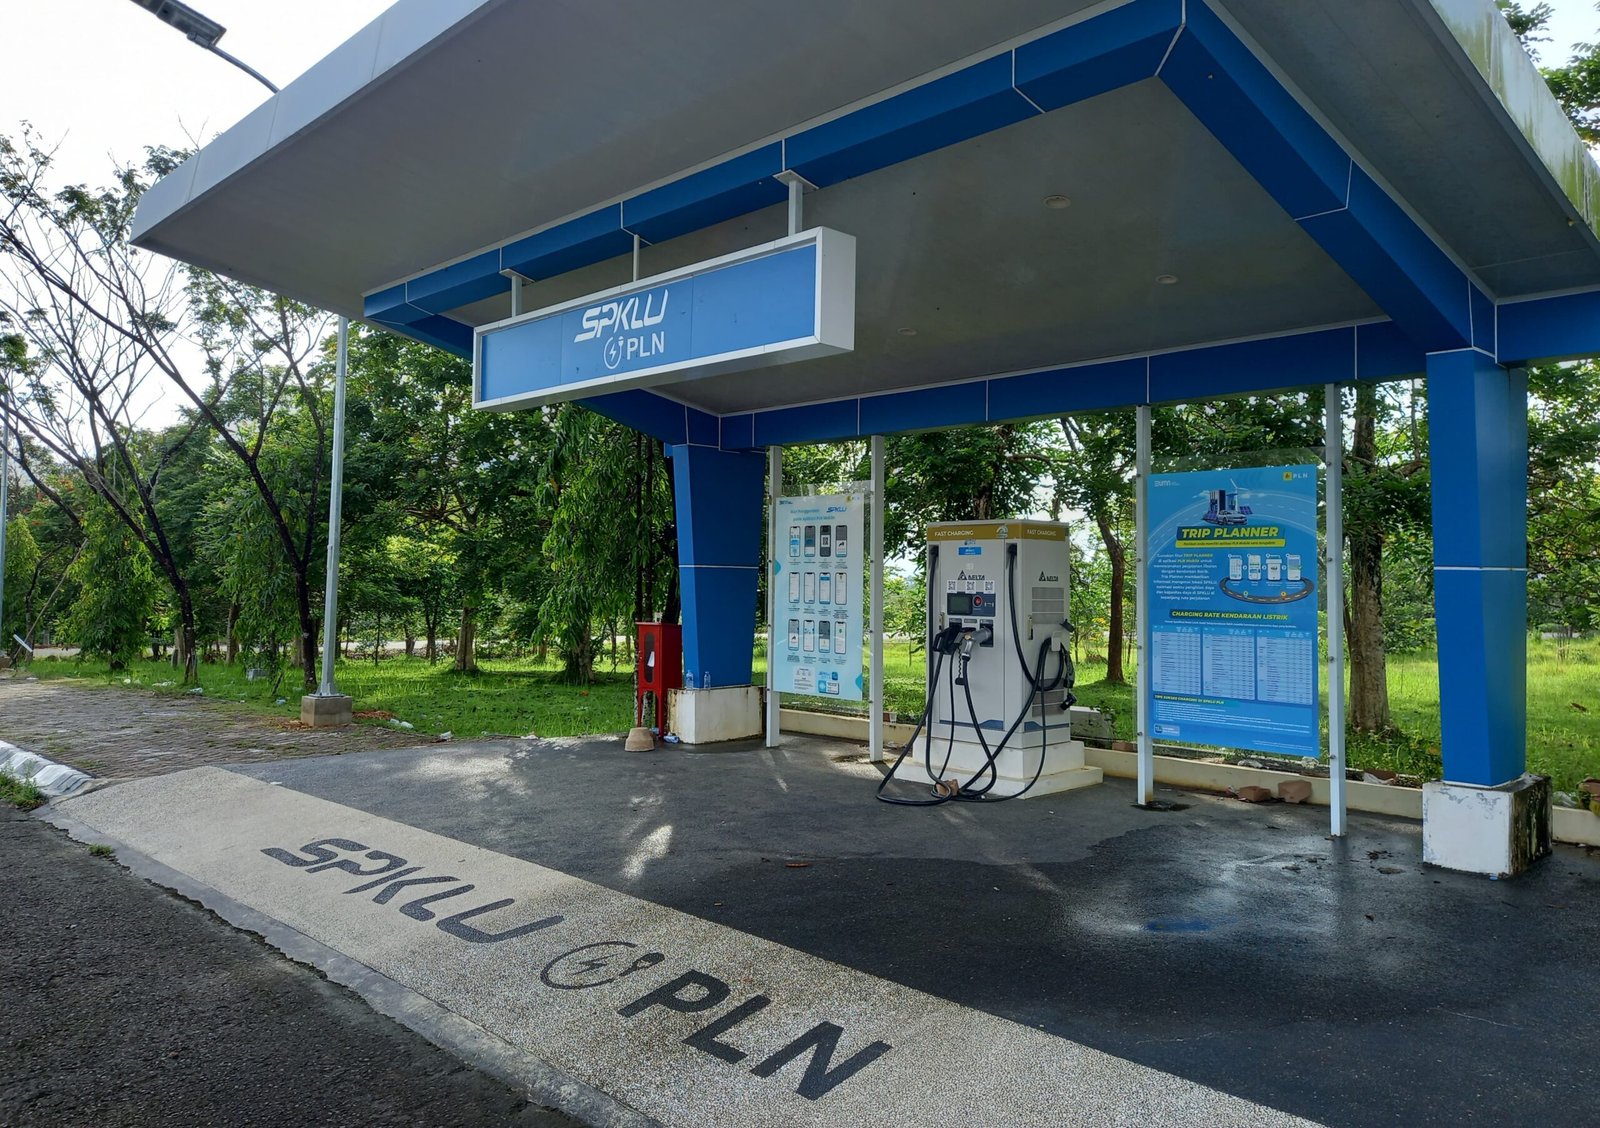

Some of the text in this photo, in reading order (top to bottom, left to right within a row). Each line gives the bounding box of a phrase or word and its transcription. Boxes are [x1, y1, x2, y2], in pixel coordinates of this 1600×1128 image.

[574, 289, 668, 343] SPKLU
[626, 331, 665, 360] PLN
[1182, 526, 1279, 538] TRIP PLANNER
[260, 838, 892, 1101] SPKLU PLN
